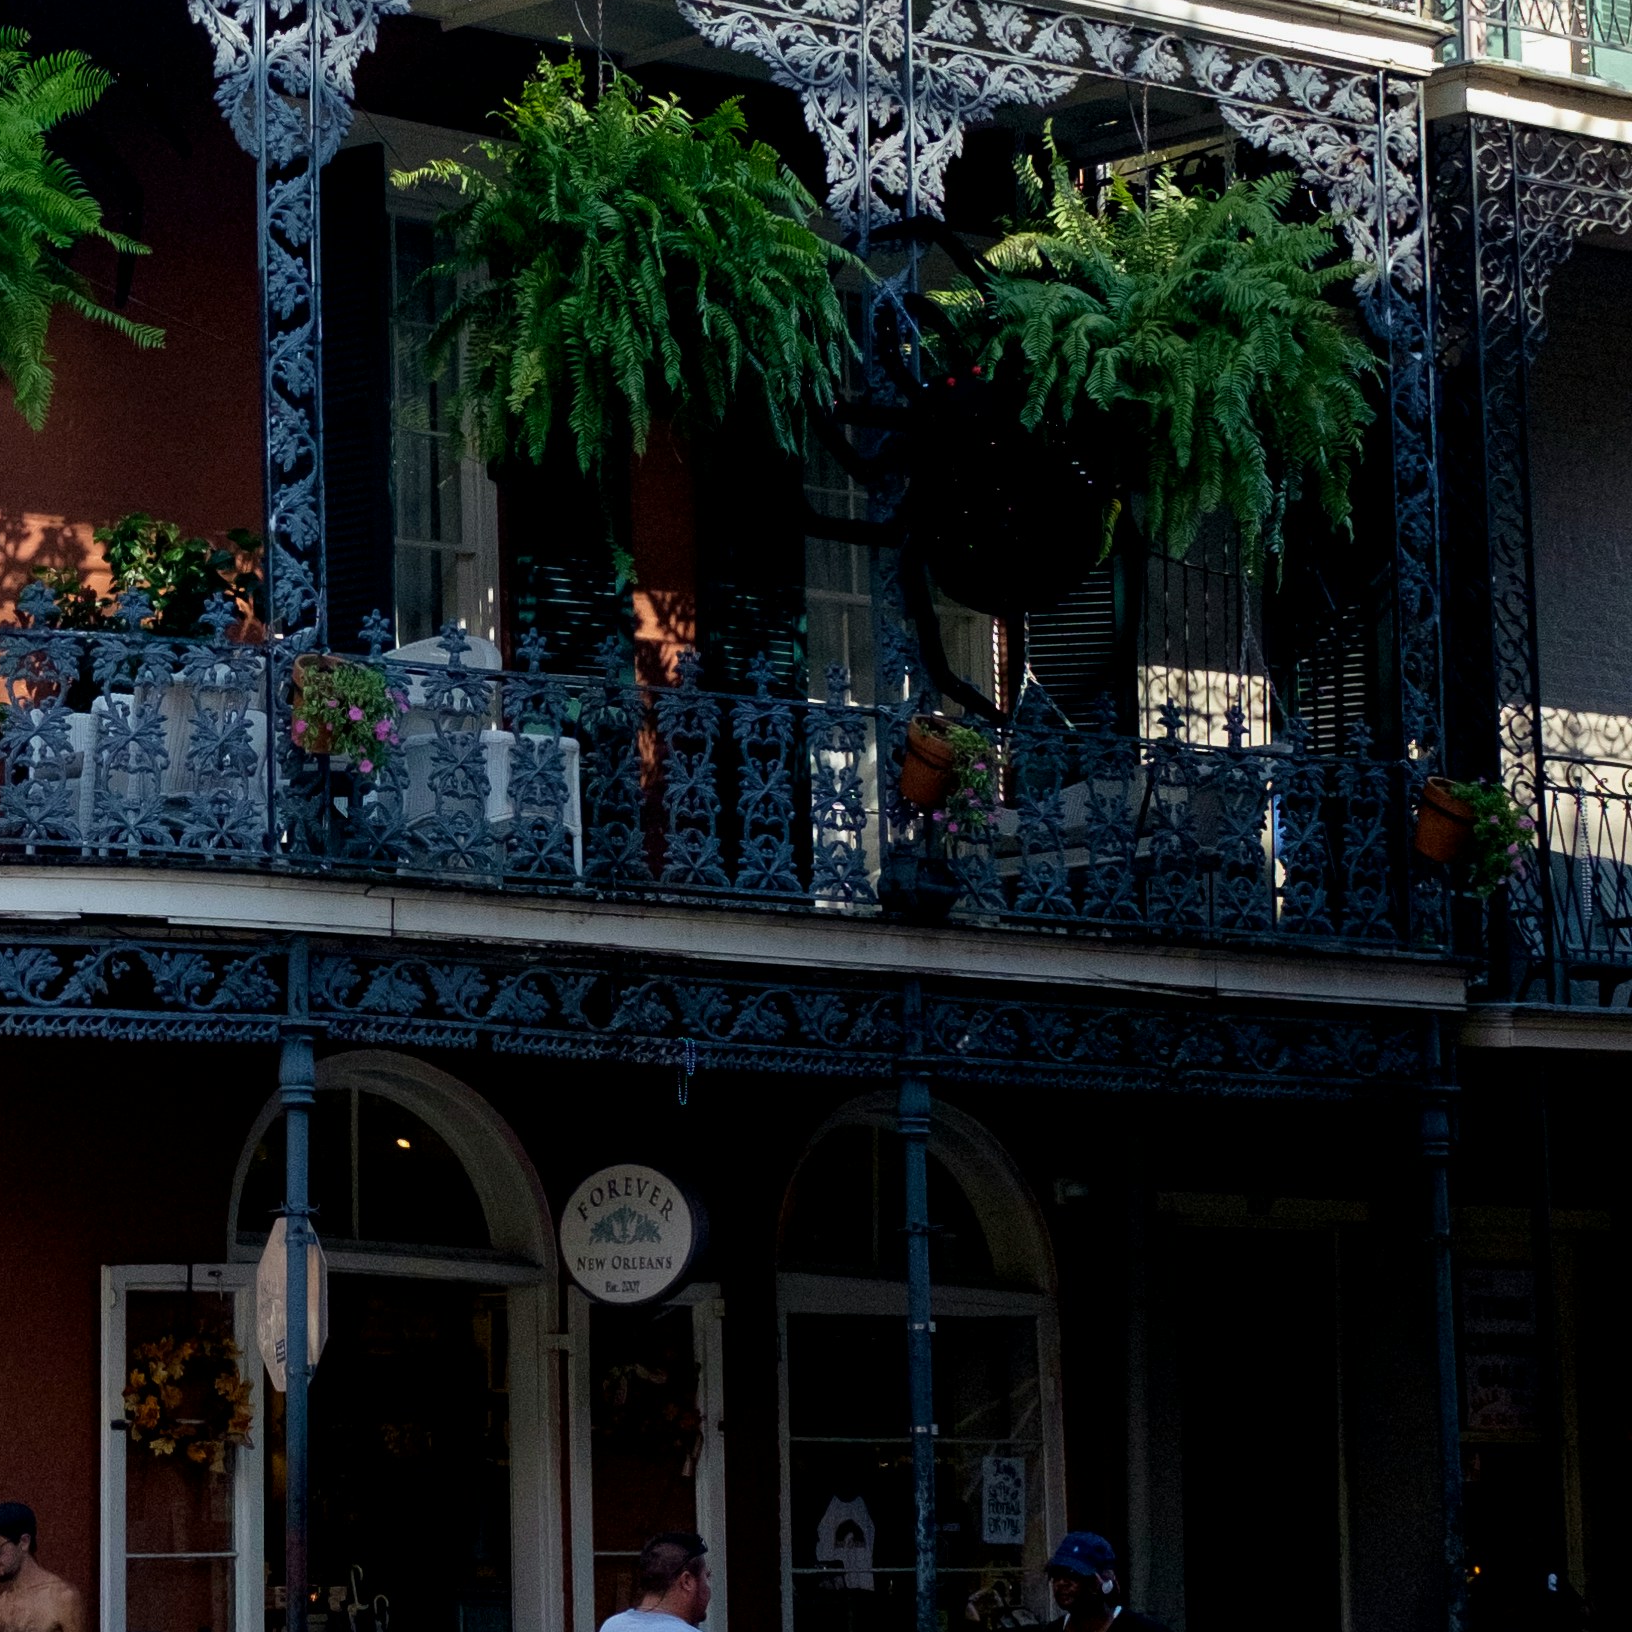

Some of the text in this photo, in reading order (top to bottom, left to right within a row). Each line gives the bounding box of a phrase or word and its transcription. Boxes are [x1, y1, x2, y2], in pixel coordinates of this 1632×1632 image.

[577, 1177, 674, 1222] FOREVER
[577, 1256, 672, 1271] NEW ORLEANS
